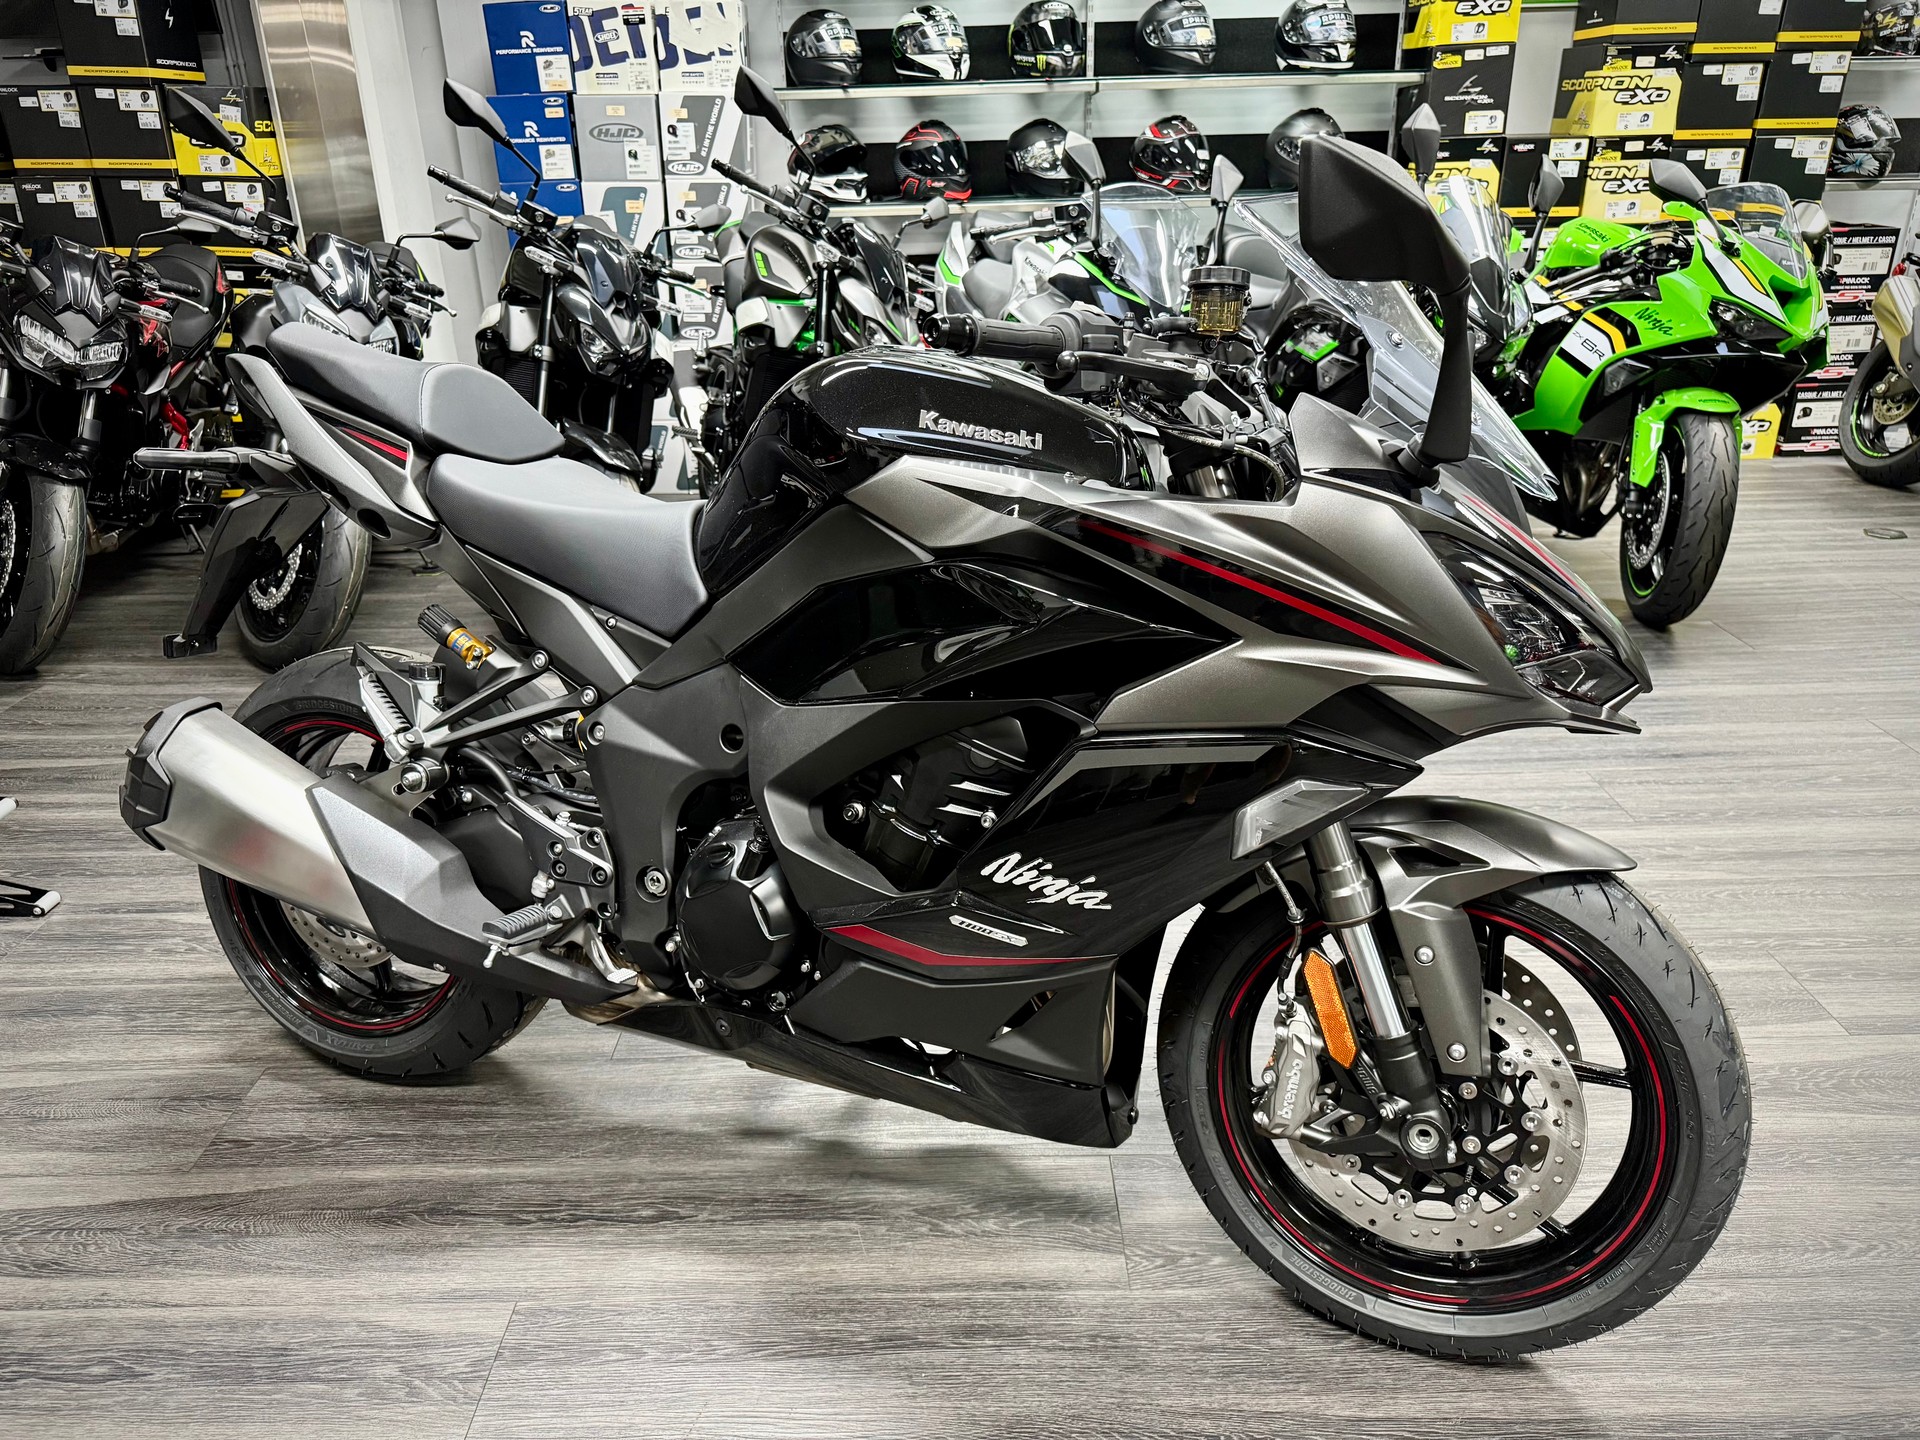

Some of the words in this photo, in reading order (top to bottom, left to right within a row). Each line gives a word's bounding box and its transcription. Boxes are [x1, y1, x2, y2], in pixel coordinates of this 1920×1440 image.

[1561, 75, 1653, 91] SCORPION
[596, 128, 637, 138] HJC
[673, 164, 700, 172] HJC
[1634, 307, 1673, 336] Ninja
[919, 409, 1043, 450] Kawasaki
[980, 851, 1112, 910] Ninja
[1277, 1058, 1304, 1120] brembo
[1289, 1254, 1357, 1301] BRIDGESTONE
